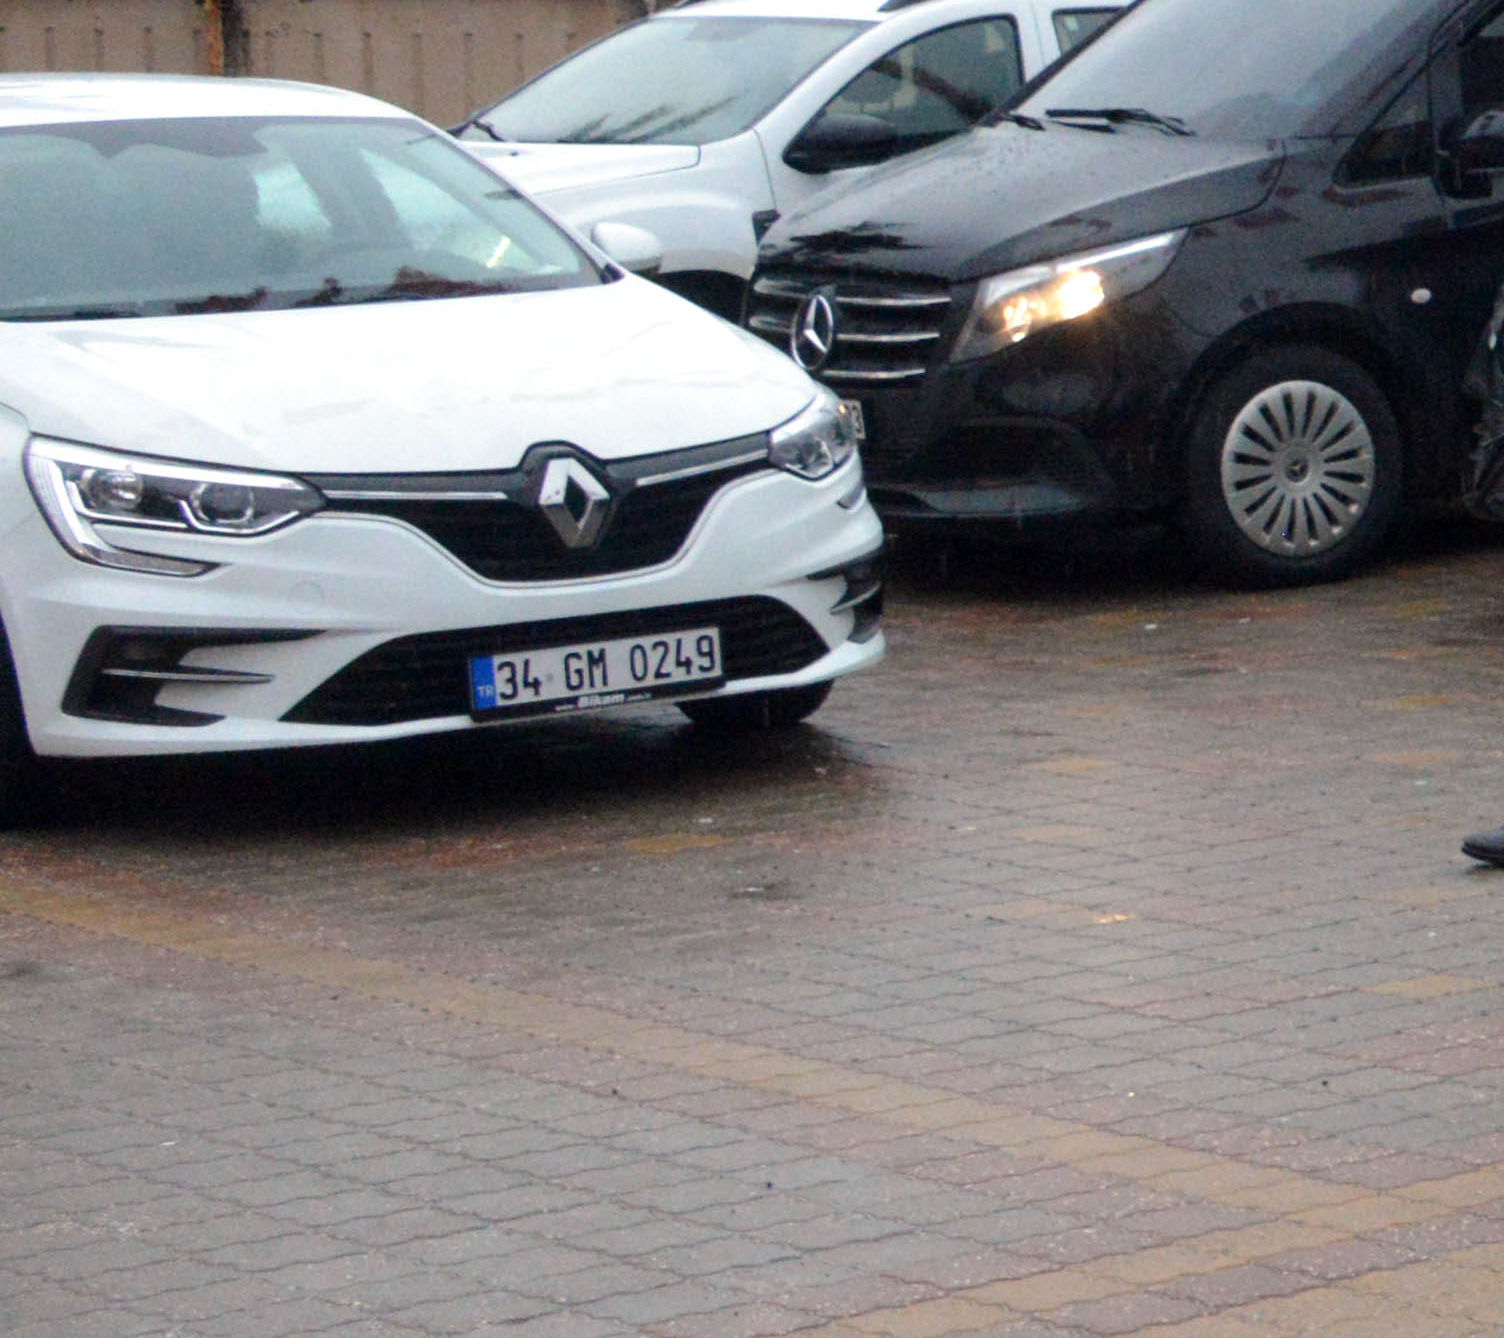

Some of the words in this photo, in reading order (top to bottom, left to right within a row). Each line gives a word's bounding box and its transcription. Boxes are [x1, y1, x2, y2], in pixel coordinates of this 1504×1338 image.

[497, 659, 542, 701] 34
[563, 647, 609, 692] GM
[629, 634, 716, 682] 0249
